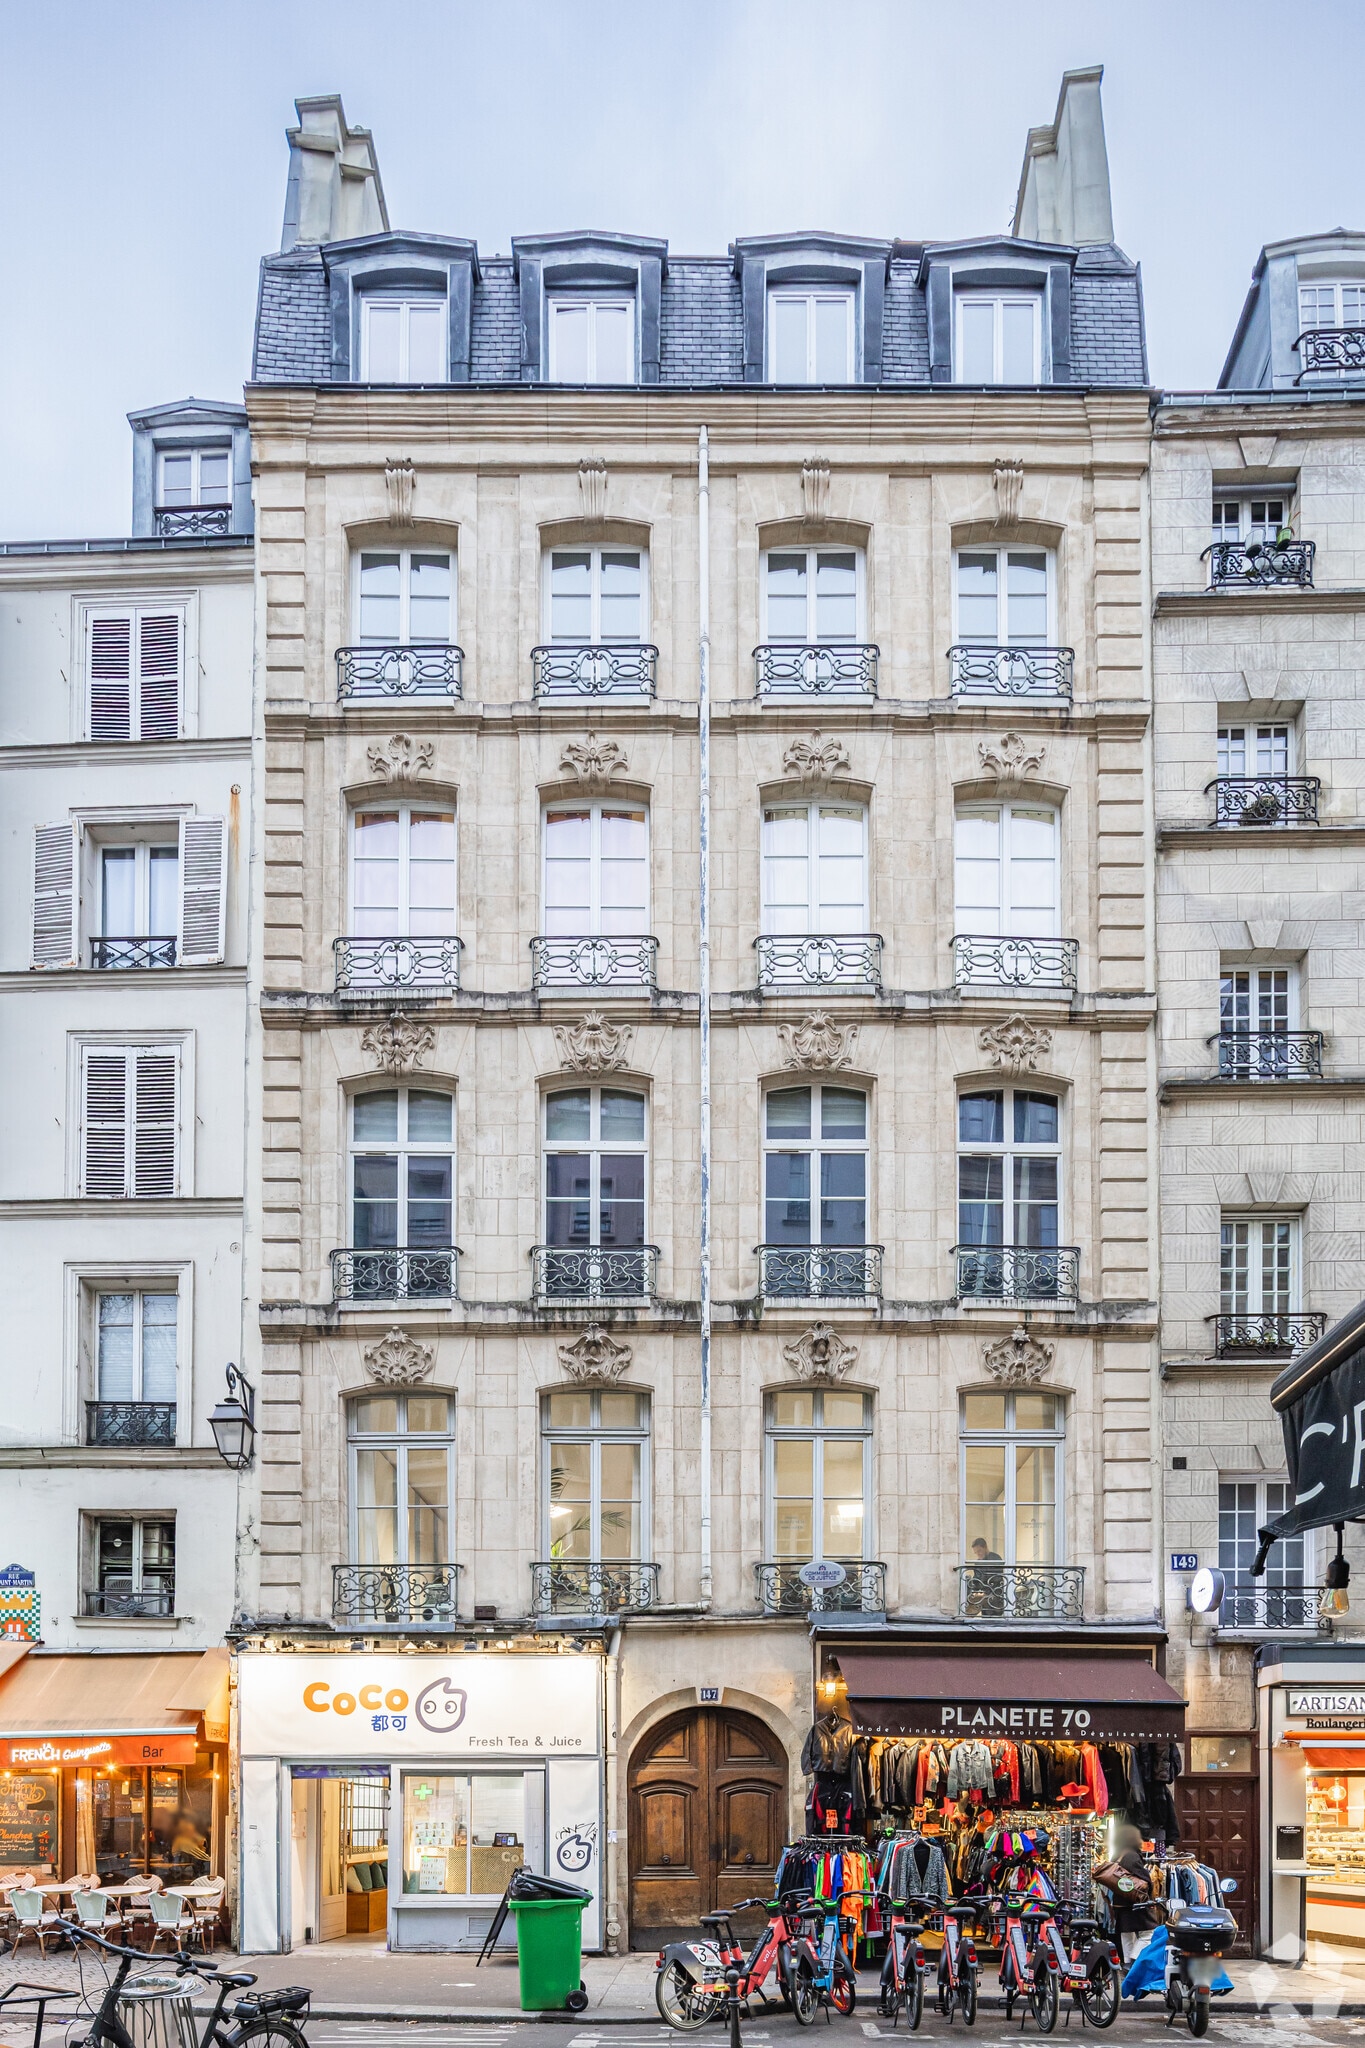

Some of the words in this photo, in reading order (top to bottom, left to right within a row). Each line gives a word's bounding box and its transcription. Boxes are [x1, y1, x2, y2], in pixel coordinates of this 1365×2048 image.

[1172, 1556, 1197, 1569] 149
[702, 1689, 717, 1699] 147
[371, 1714, 408, 1732] 都可
[941, 1706, 1054, 1727] PLANETE
[1061, 1709, 1091, 1728] 70
[856, 1725, 889, 1733] Mode
[900, 1726, 961, 1735] Vintage,
[971, 1728, 1054, 1736] Accessoires
[1080, 1729, 1178, 1738] Déguisements
[469, 1736, 503, 1747] Fresh
[508, 1736, 529, 1747] Tea
[534, 1736, 543, 1747] &
[549, 1736, 582, 1747] Juice
[12, 1748, 60, 1762] FRENCH
[142, 1746, 164, 1758] Bar
[698, 1947, 707, 1962] 3
